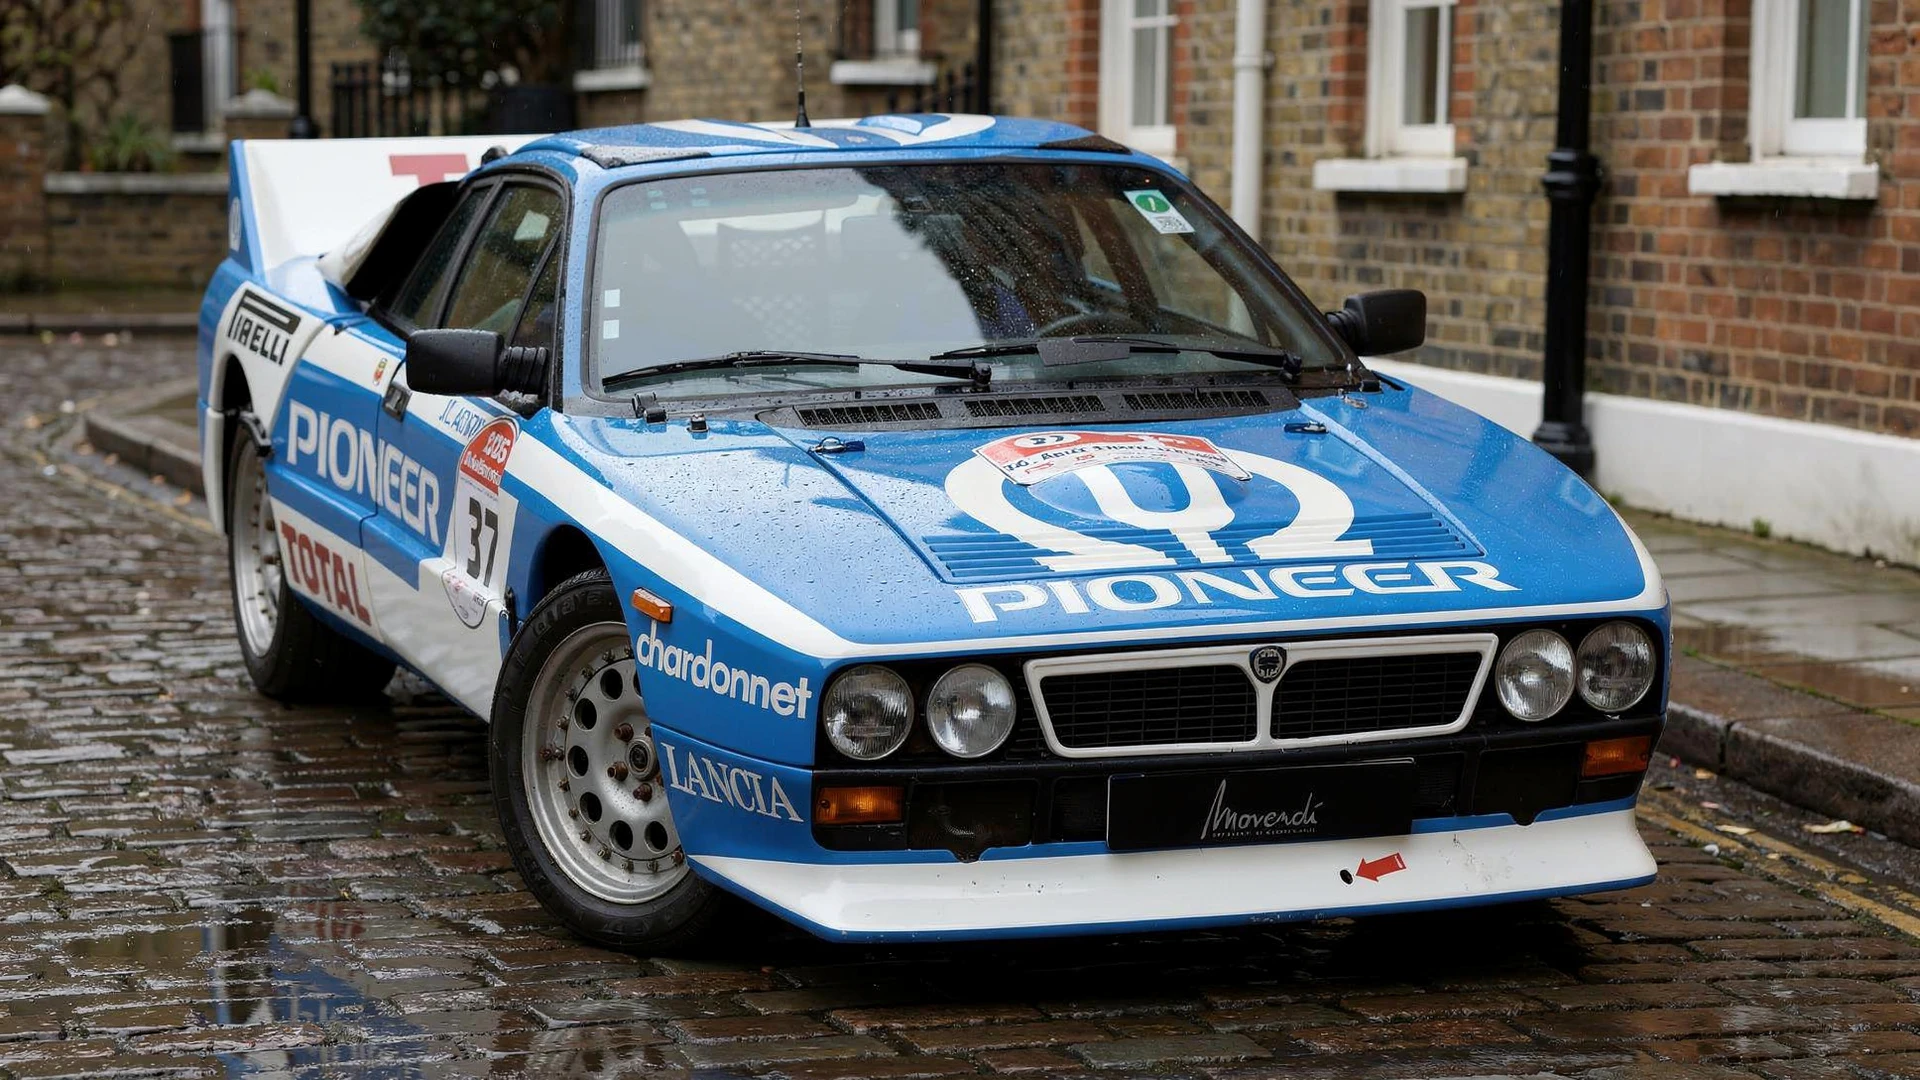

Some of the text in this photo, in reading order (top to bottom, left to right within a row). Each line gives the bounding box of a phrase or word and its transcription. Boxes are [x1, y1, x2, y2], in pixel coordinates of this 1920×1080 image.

[227, 288, 301, 367] PIRELLI
[286, 398, 441, 547] PIONEER
[281, 520, 372, 627] TOTAL
[466, 497, 498, 588] 37
[954, 561, 1523, 623] PIONEER
[636, 619, 813, 719] chardonnet
[660, 742, 804, 823] LANCIA
